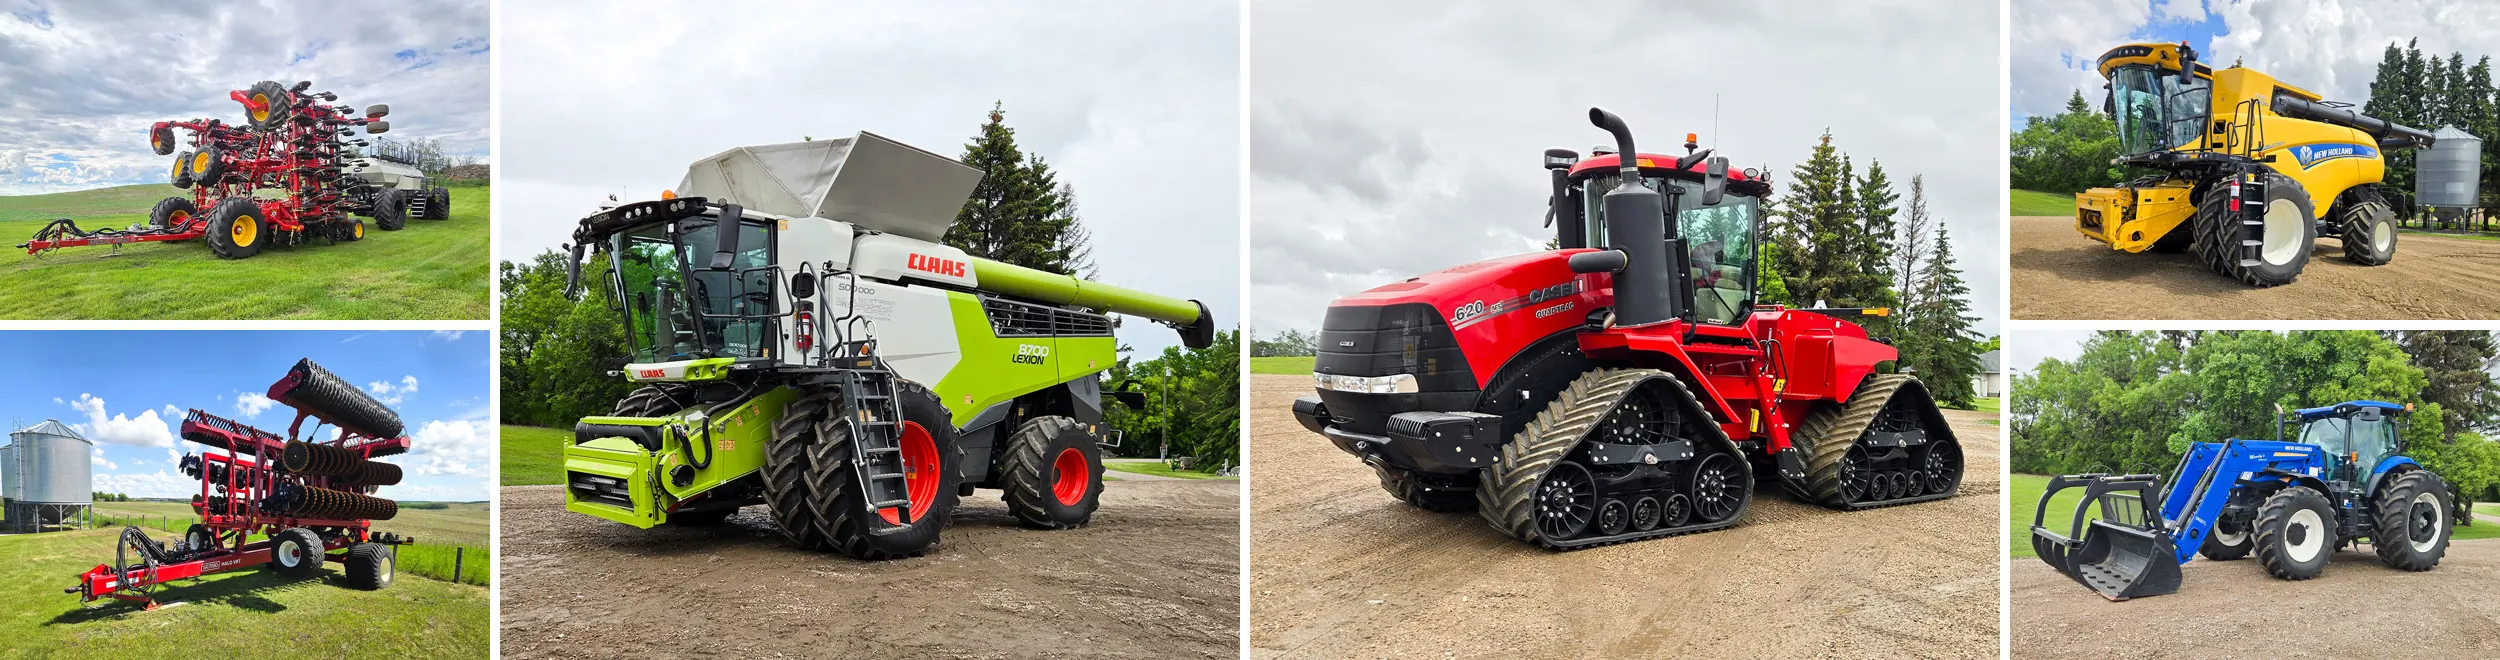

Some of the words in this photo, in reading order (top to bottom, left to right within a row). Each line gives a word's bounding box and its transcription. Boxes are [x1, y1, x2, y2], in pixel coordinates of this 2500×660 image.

[2313, 150, 2328, 160] NEW
[2329, 147, 2353, 156] HOLLAND
[591, 212, 610, 224] LEXION
[908, 252, 966, 278] CLAAS
[1455, 300, 1484, 321] 620
[1536, 301, 1574, 318] QUADTRAC
[1019, 344, 1049, 357] 8700
[1012, 353, 1044, 365] LEXION
